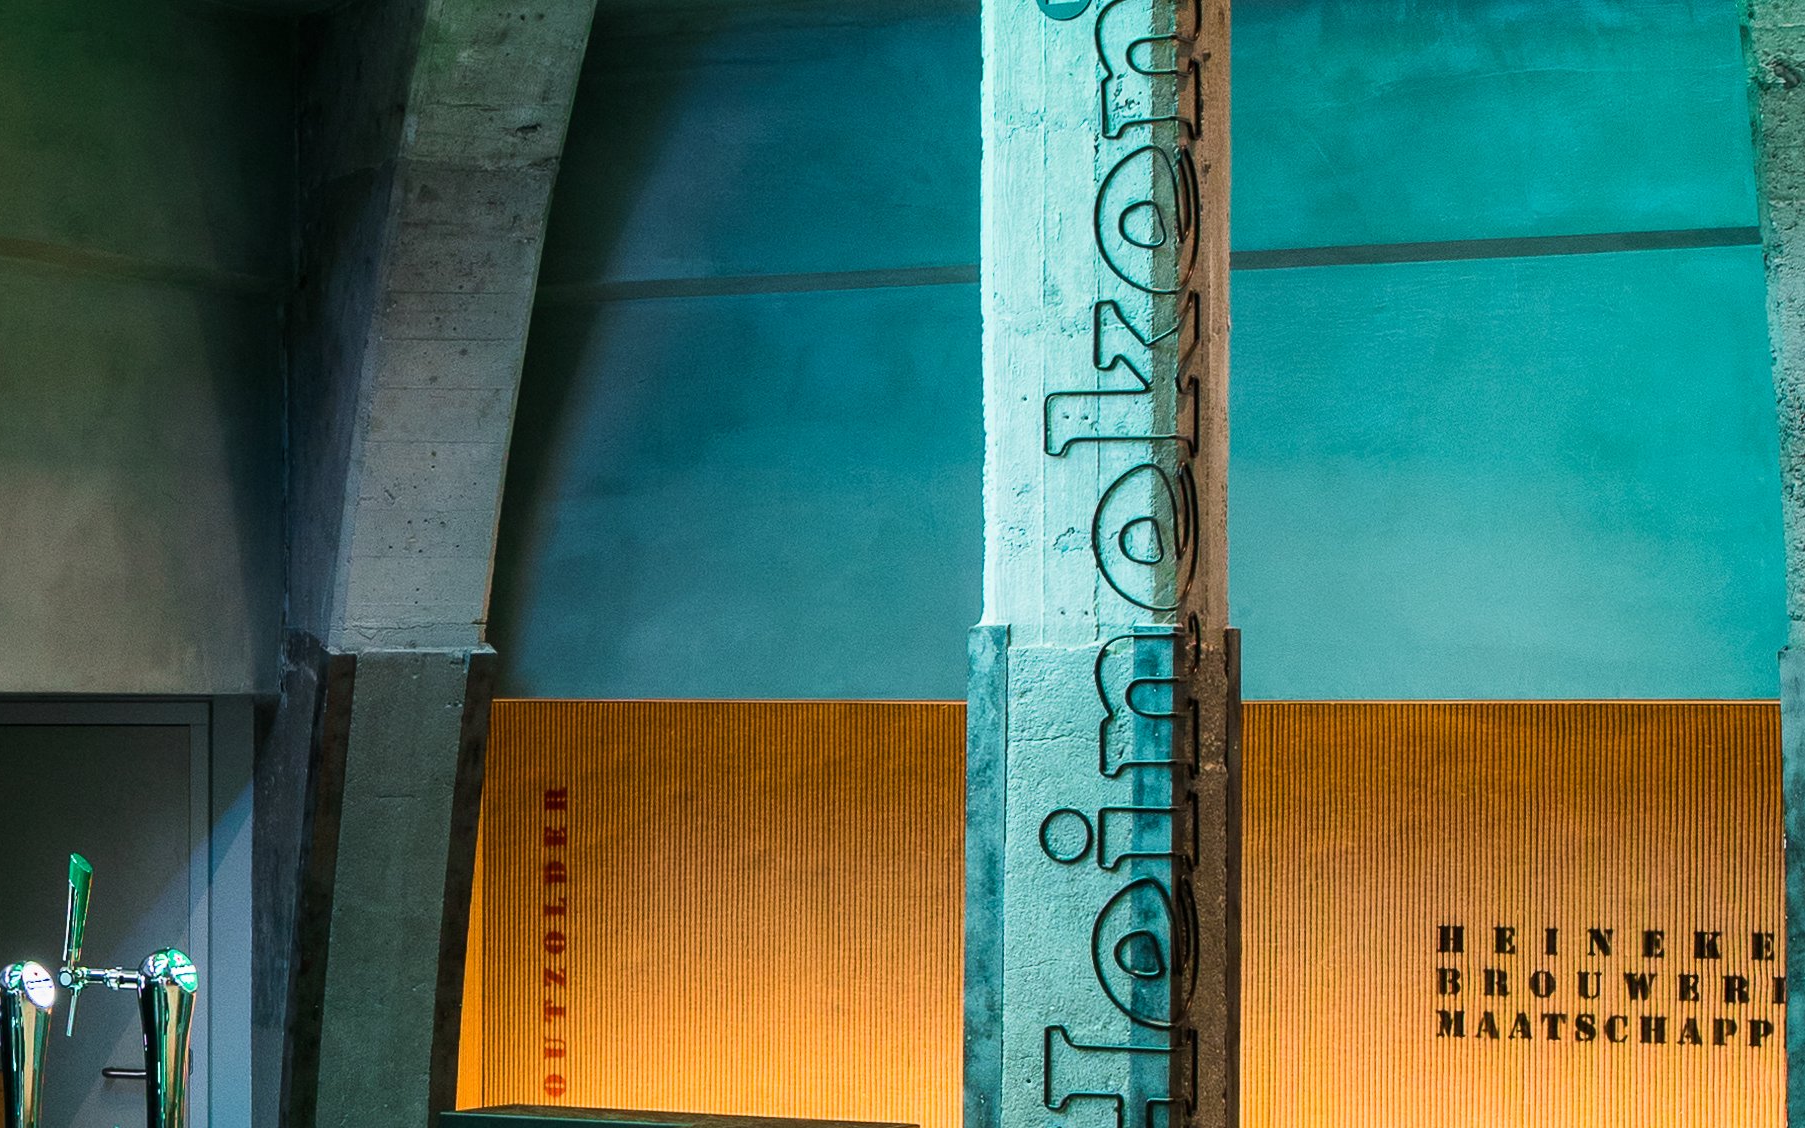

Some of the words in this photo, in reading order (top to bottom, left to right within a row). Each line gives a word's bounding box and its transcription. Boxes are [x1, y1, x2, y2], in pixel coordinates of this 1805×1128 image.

[543, 786, 568, 1098] OUTZOLDER
[1436, 924, 1775, 961] HEINEKE
[1436, 1009, 1786, 1048] MAATSCHAPP
